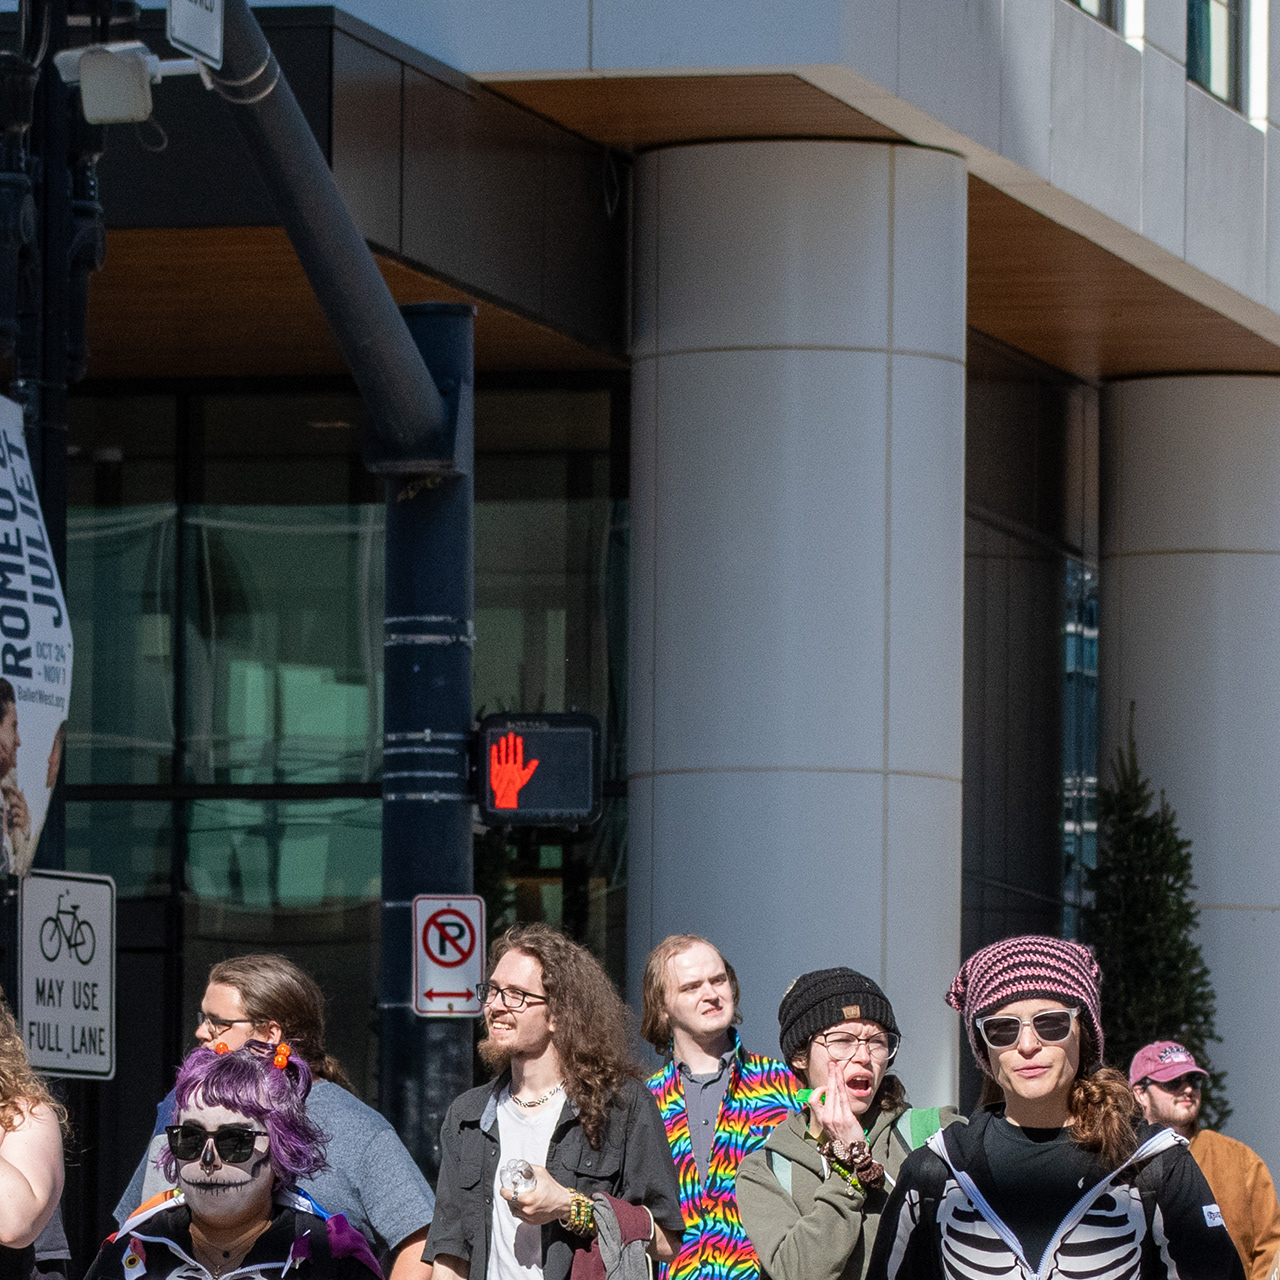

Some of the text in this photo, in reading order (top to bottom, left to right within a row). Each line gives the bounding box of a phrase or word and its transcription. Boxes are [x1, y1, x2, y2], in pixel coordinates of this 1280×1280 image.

[3, 430, 62, 629] JULIET
[35, 977, 99, 1012] MAY USE
[29, 1021, 106, 1056] FULL LANE
